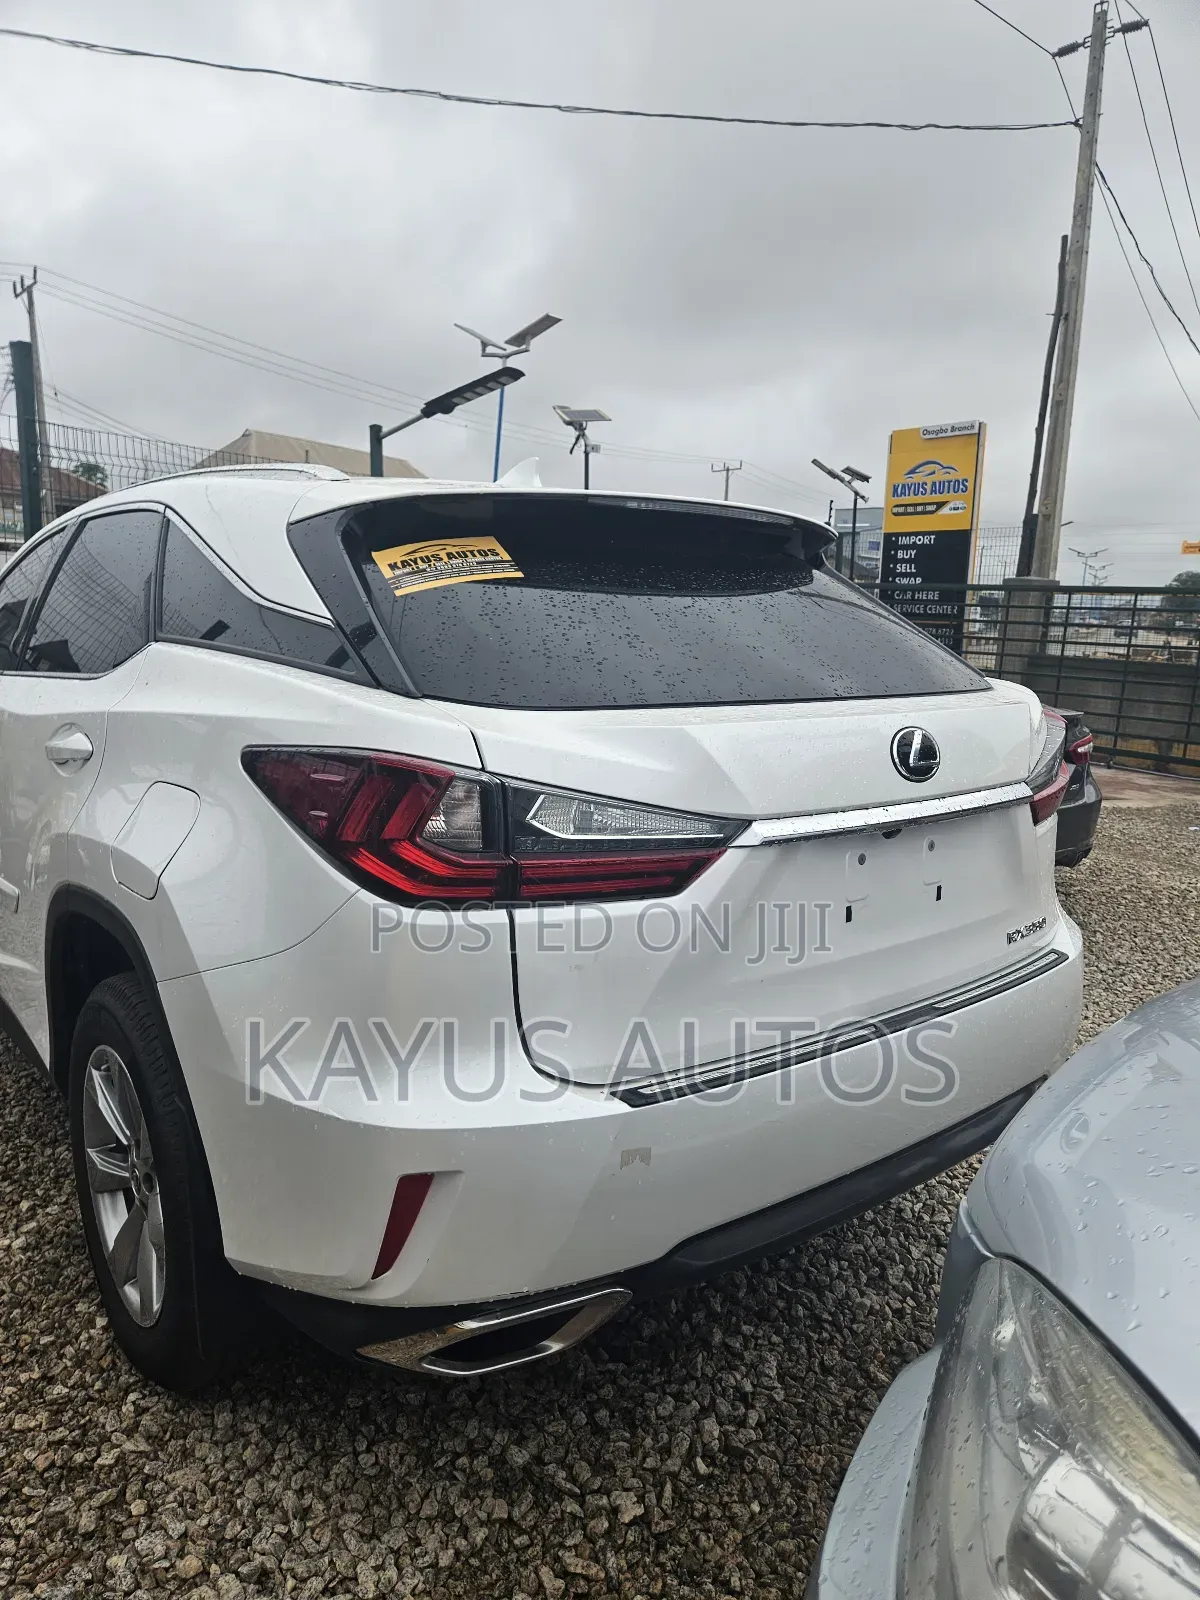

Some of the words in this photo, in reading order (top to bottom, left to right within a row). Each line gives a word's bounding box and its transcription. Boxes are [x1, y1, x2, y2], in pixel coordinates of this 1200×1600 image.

[922, 427, 948, 436] Osogbo
[950, 423, 975, 433] Branch
[892, 482, 928, 498] KAYUS
[930, 478, 969, 495] AUTOS
[898, 535, 936, 545] IMPORT
[387, 553, 444, 571] KAYUS
[445, 548, 501, 560] AUTOS
[897, 550, 917, 559] BUY
[895, 564, 917, 573] SELL
[914, 591, 940, 600] HERE
[893, 603, 924, 613] SERVICE
